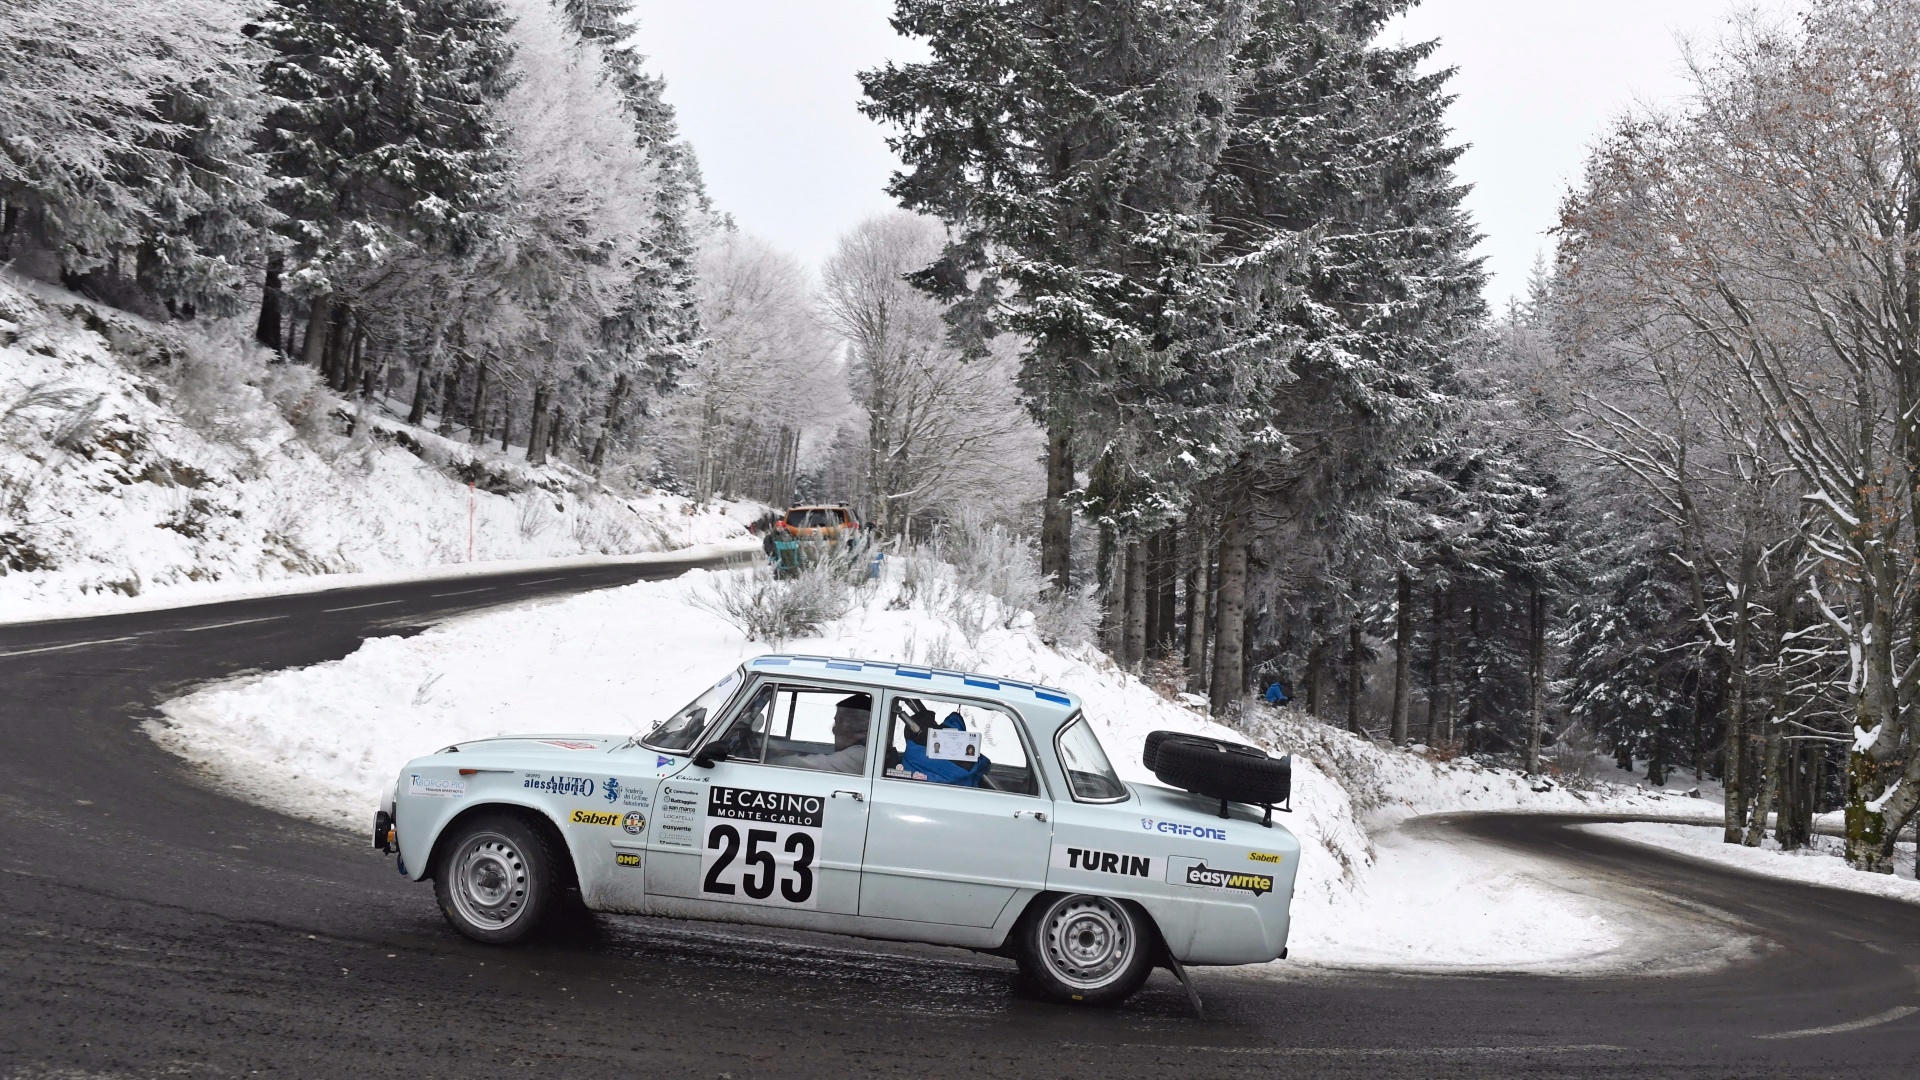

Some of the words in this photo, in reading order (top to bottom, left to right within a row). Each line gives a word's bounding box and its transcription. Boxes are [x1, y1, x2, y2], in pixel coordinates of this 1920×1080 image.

[451, 781, 465, 790] PIO
[524, 779, 585, 793] alessandria
[545, 776, 595, 797] AUTO
[625, 786, 644, 795] Scuderia
[712, 788, 734, 805] LE
[738, 791, 820, 814] CASINO
[679, 805, 696, 813] marco
[573, 811, 619, 826] Sabelt
[664, 813, 694, 821] LOCATELLI
[717, 808, 762, 820] MONTE
[770, 814, 812, 826] CARLO
[662, 824, 692, 832] easywrite
[1157, 821, 1226, 841] GRIFONE
[617, 855, 640, 865] OMP
[703, 824, 815, 903] 253
[1067, 848, 1151, 877] TURIN
[1249, 852, 1279, 863] Sabelt
[1189, 868, 1271, 891] easywrite
